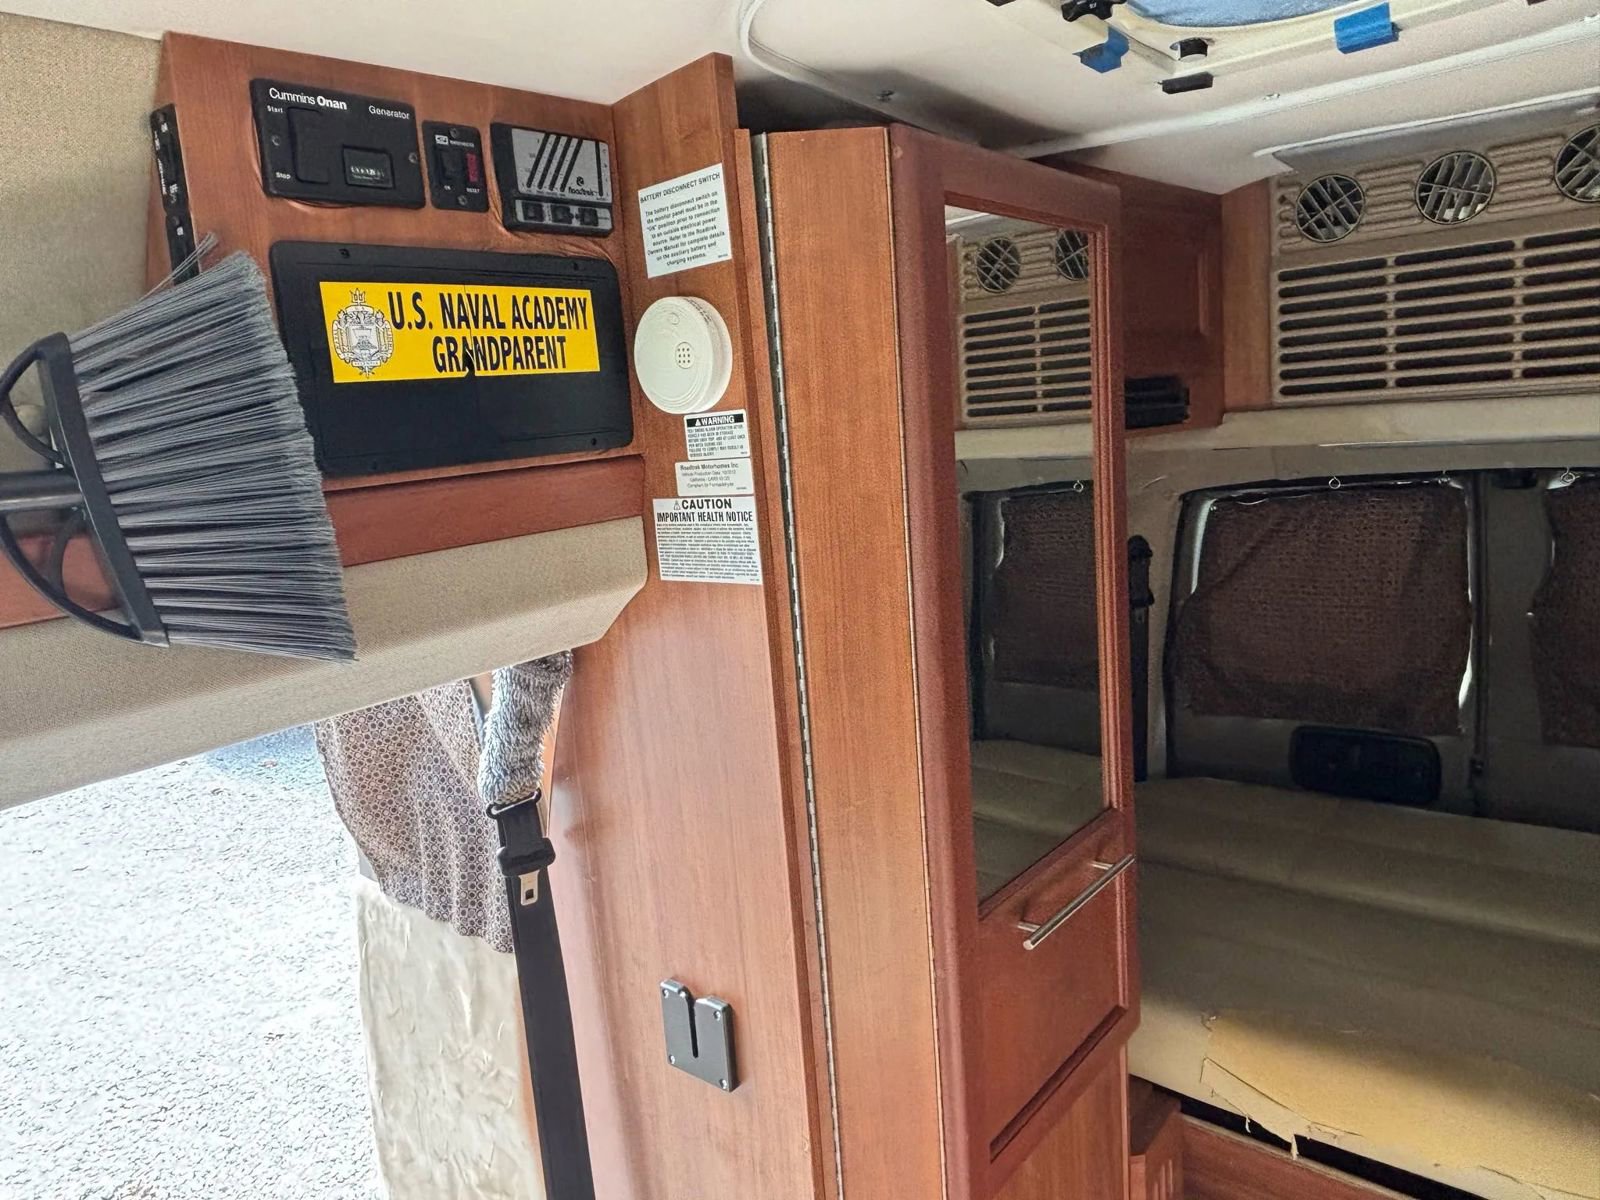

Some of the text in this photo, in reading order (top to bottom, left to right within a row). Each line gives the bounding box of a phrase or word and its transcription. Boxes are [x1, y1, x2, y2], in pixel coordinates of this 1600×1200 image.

[269, 87, 347, 110] Cummins Onan
[267, 105, 283, 113] Start
[368, 105, 410, 119] Generator
[640, 172, 720, 203] BATTERY DISCONNECT SWITCH
[670, 198, 694, 209] disconnect
[696, 193, 710, 201] switch
[672, 209, 684, 218] panel
[702, 217, 716, 225] power
[387, 291, 588, 330] U.S. NAVAL ACADEMY
[432, 336, 566, 373] GRANDPARENT
[701, 416, 734, 426] WARNING
[682, 499, 732, 510] CAUTION
[657, 511, 752, 522] IMPORTANT HEALTH NOTICE
